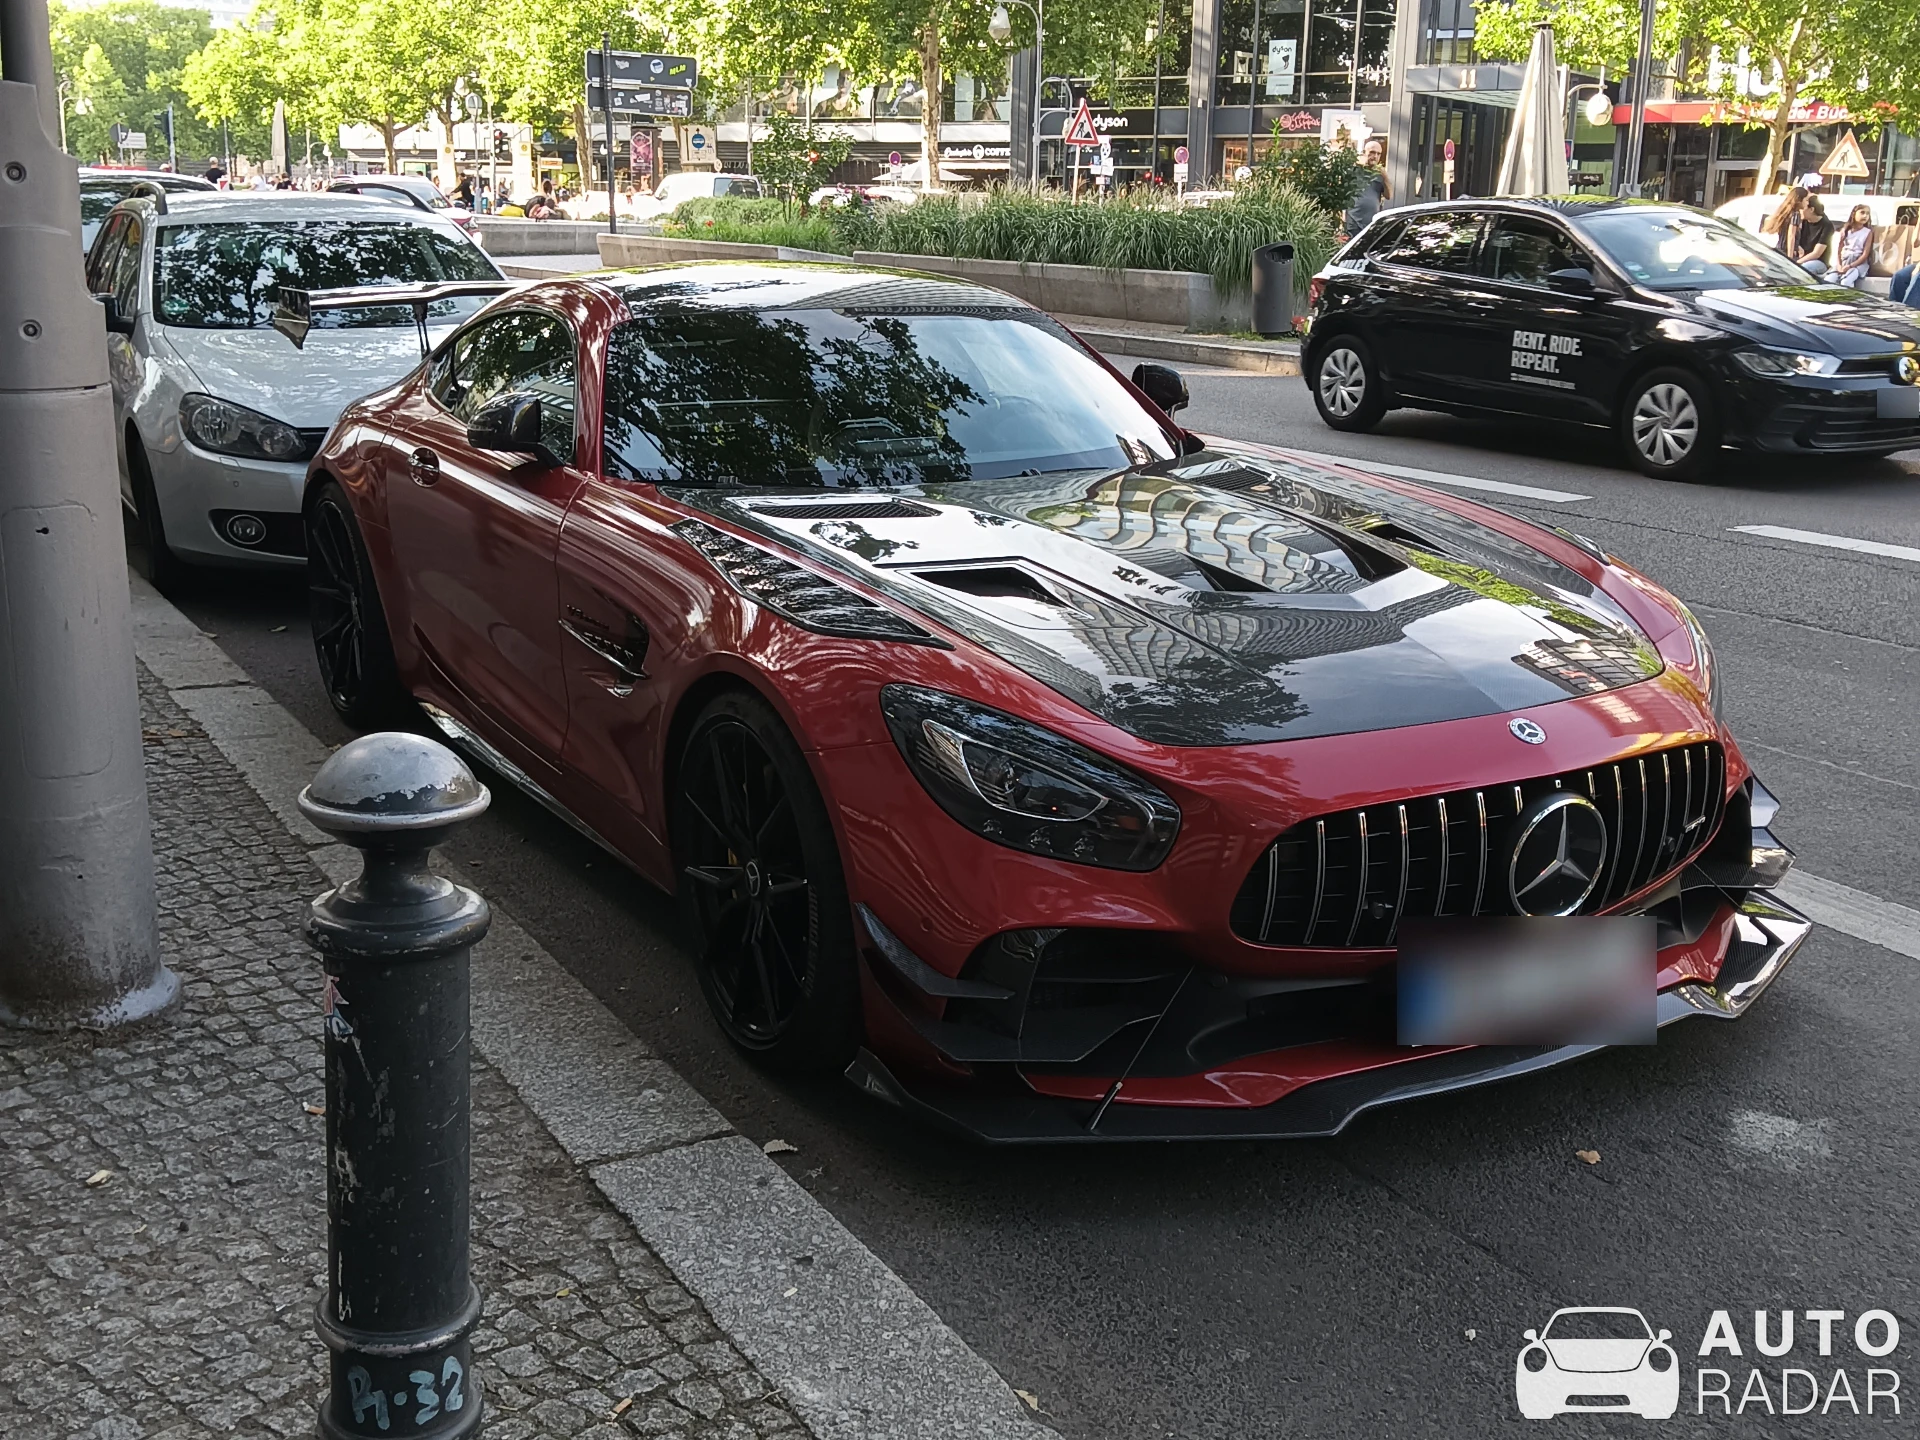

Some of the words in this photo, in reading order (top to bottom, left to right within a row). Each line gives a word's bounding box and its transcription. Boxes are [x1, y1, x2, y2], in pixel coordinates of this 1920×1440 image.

[1272, 46, 1292, 54] dyson
[1460, 69, 1477, 88] 11
[1093, 114, 1128, 131] dyson
[1513, 330, 1547, 351] RENT.
[1549, 335, 1582, 356] RIDE.
[1511, 350, 1559, 373] REPEAT.
